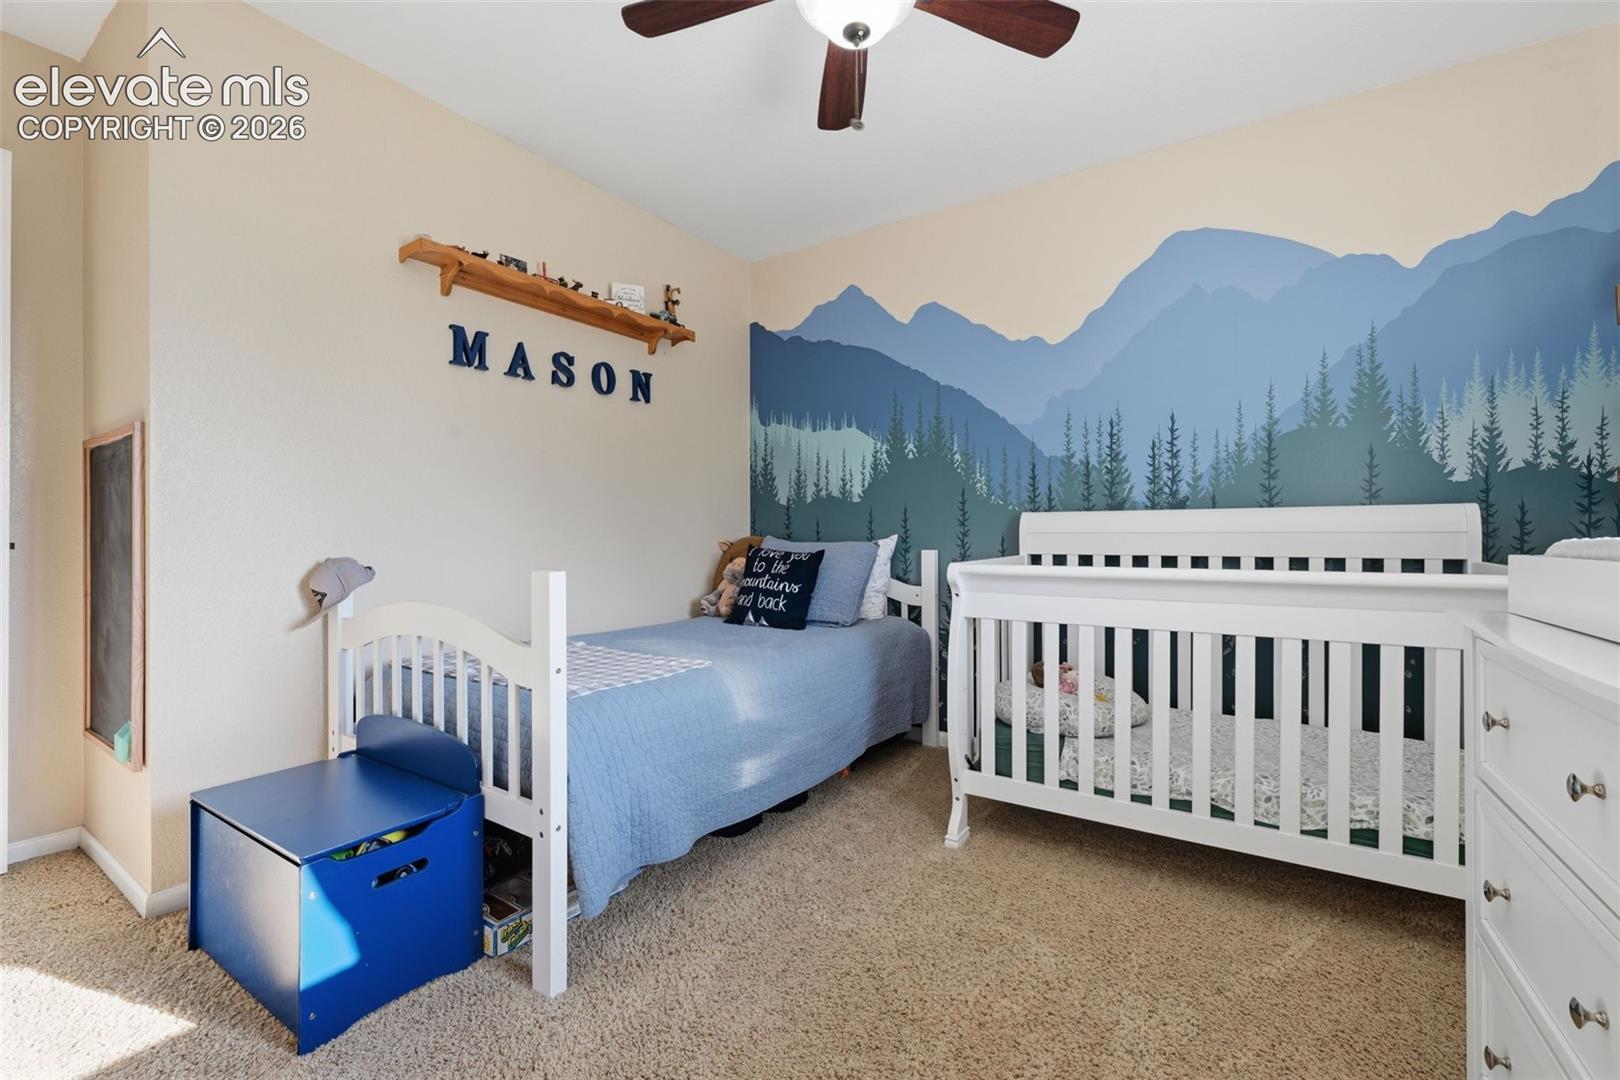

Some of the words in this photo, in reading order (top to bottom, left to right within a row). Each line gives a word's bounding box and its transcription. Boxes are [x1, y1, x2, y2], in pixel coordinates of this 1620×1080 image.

[448, 323, 653, 404] MASON
[752, 557, 766, 573] to
[771, 559, 790, 575] the
[786, 552, 811, 564] you
[741, 573, 802, 593] ountains
[757, 592, 787, 612] back
